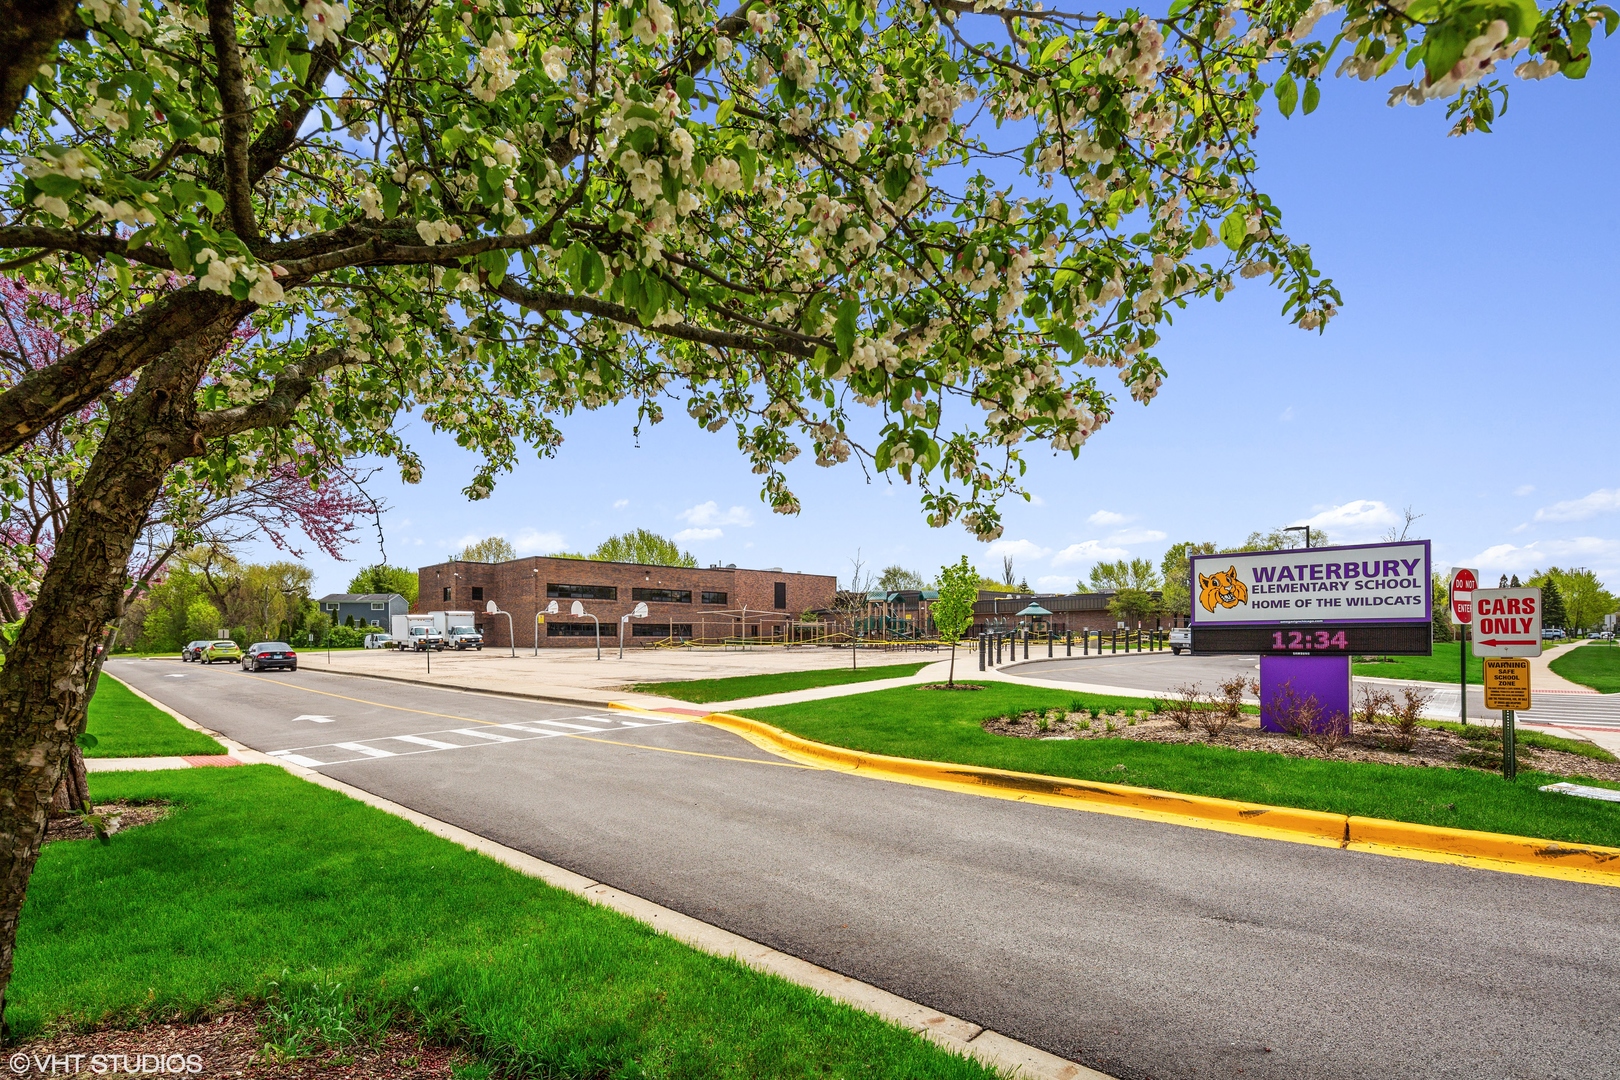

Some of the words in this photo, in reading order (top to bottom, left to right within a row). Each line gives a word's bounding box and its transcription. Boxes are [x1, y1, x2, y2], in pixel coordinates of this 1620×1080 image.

[1252, 558, 1421, 583] WATERBURY
[1252, 581, 1349, 594] ELEMENTARY
[1355, 578, 1421, 590] SCHOOL
[1456, 579, 1463, 588] DO
[1466, 580, 1474, 588] NOT
[1252, 600, 1290, 609] HOME
[1294, 599, 1312, 608] OF
[1316, 598, 1342, 608] THE
[1346, 596, 1421, 606] WILDCATS
[1478, 598, 1536, 616] CARS
[1480, 618, 1533, 634] ONLY
[1272, 631, 1348, 650] 12:34
